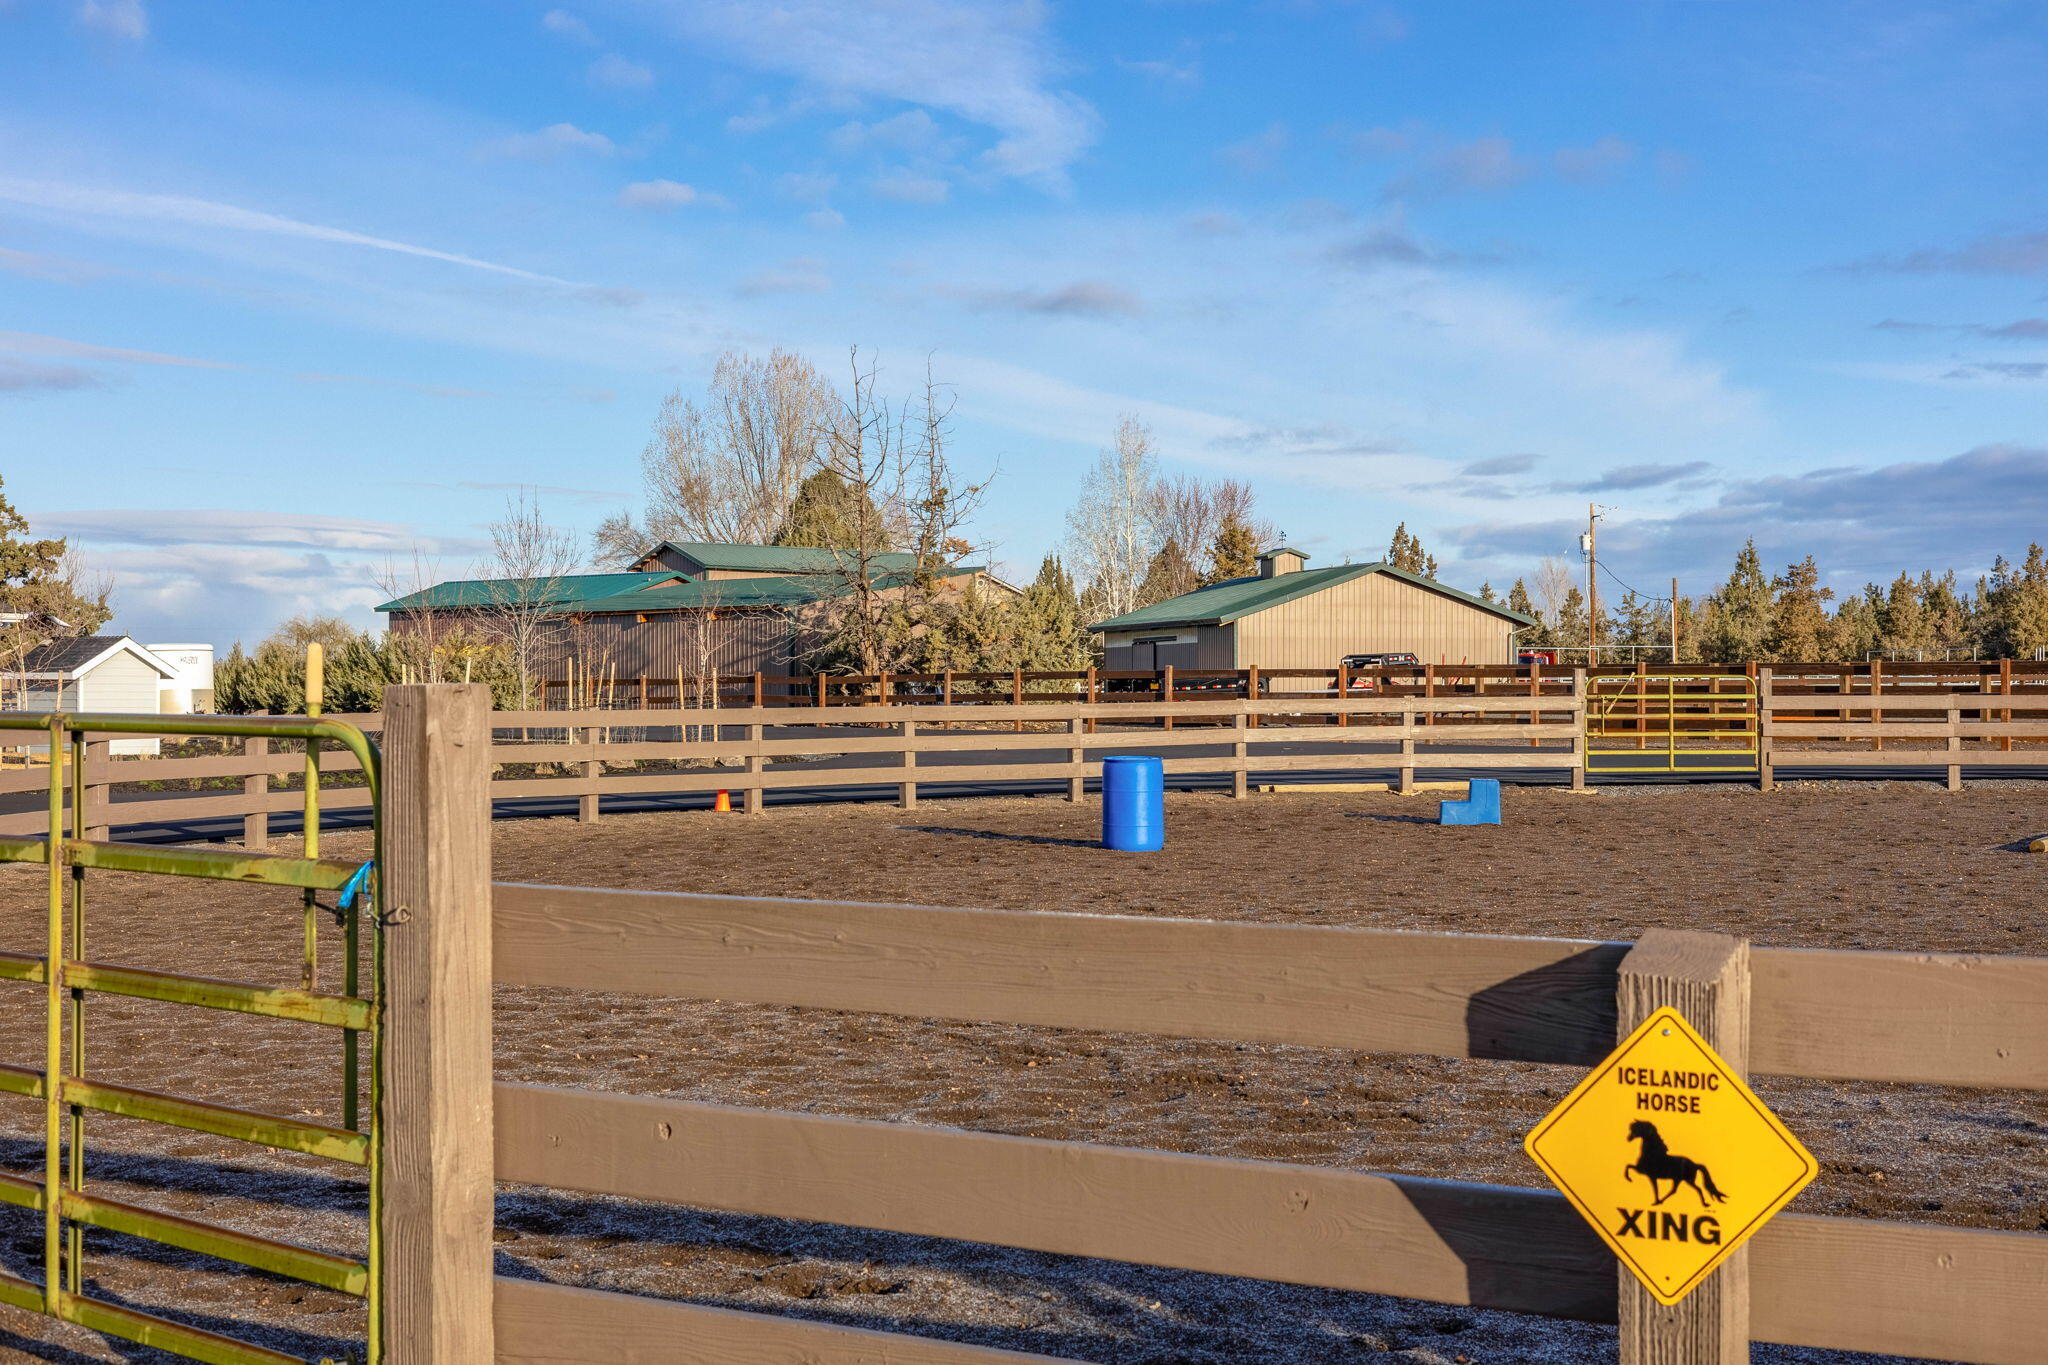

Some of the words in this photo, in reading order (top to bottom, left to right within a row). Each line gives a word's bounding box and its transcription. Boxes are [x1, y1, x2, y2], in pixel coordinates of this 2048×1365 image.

[1618, 1067, 1719, 1091] ICELANDIC
[1637, 1092, 1701, 1114] HORSE
[1615, 1207, 1721, 1246] XING
